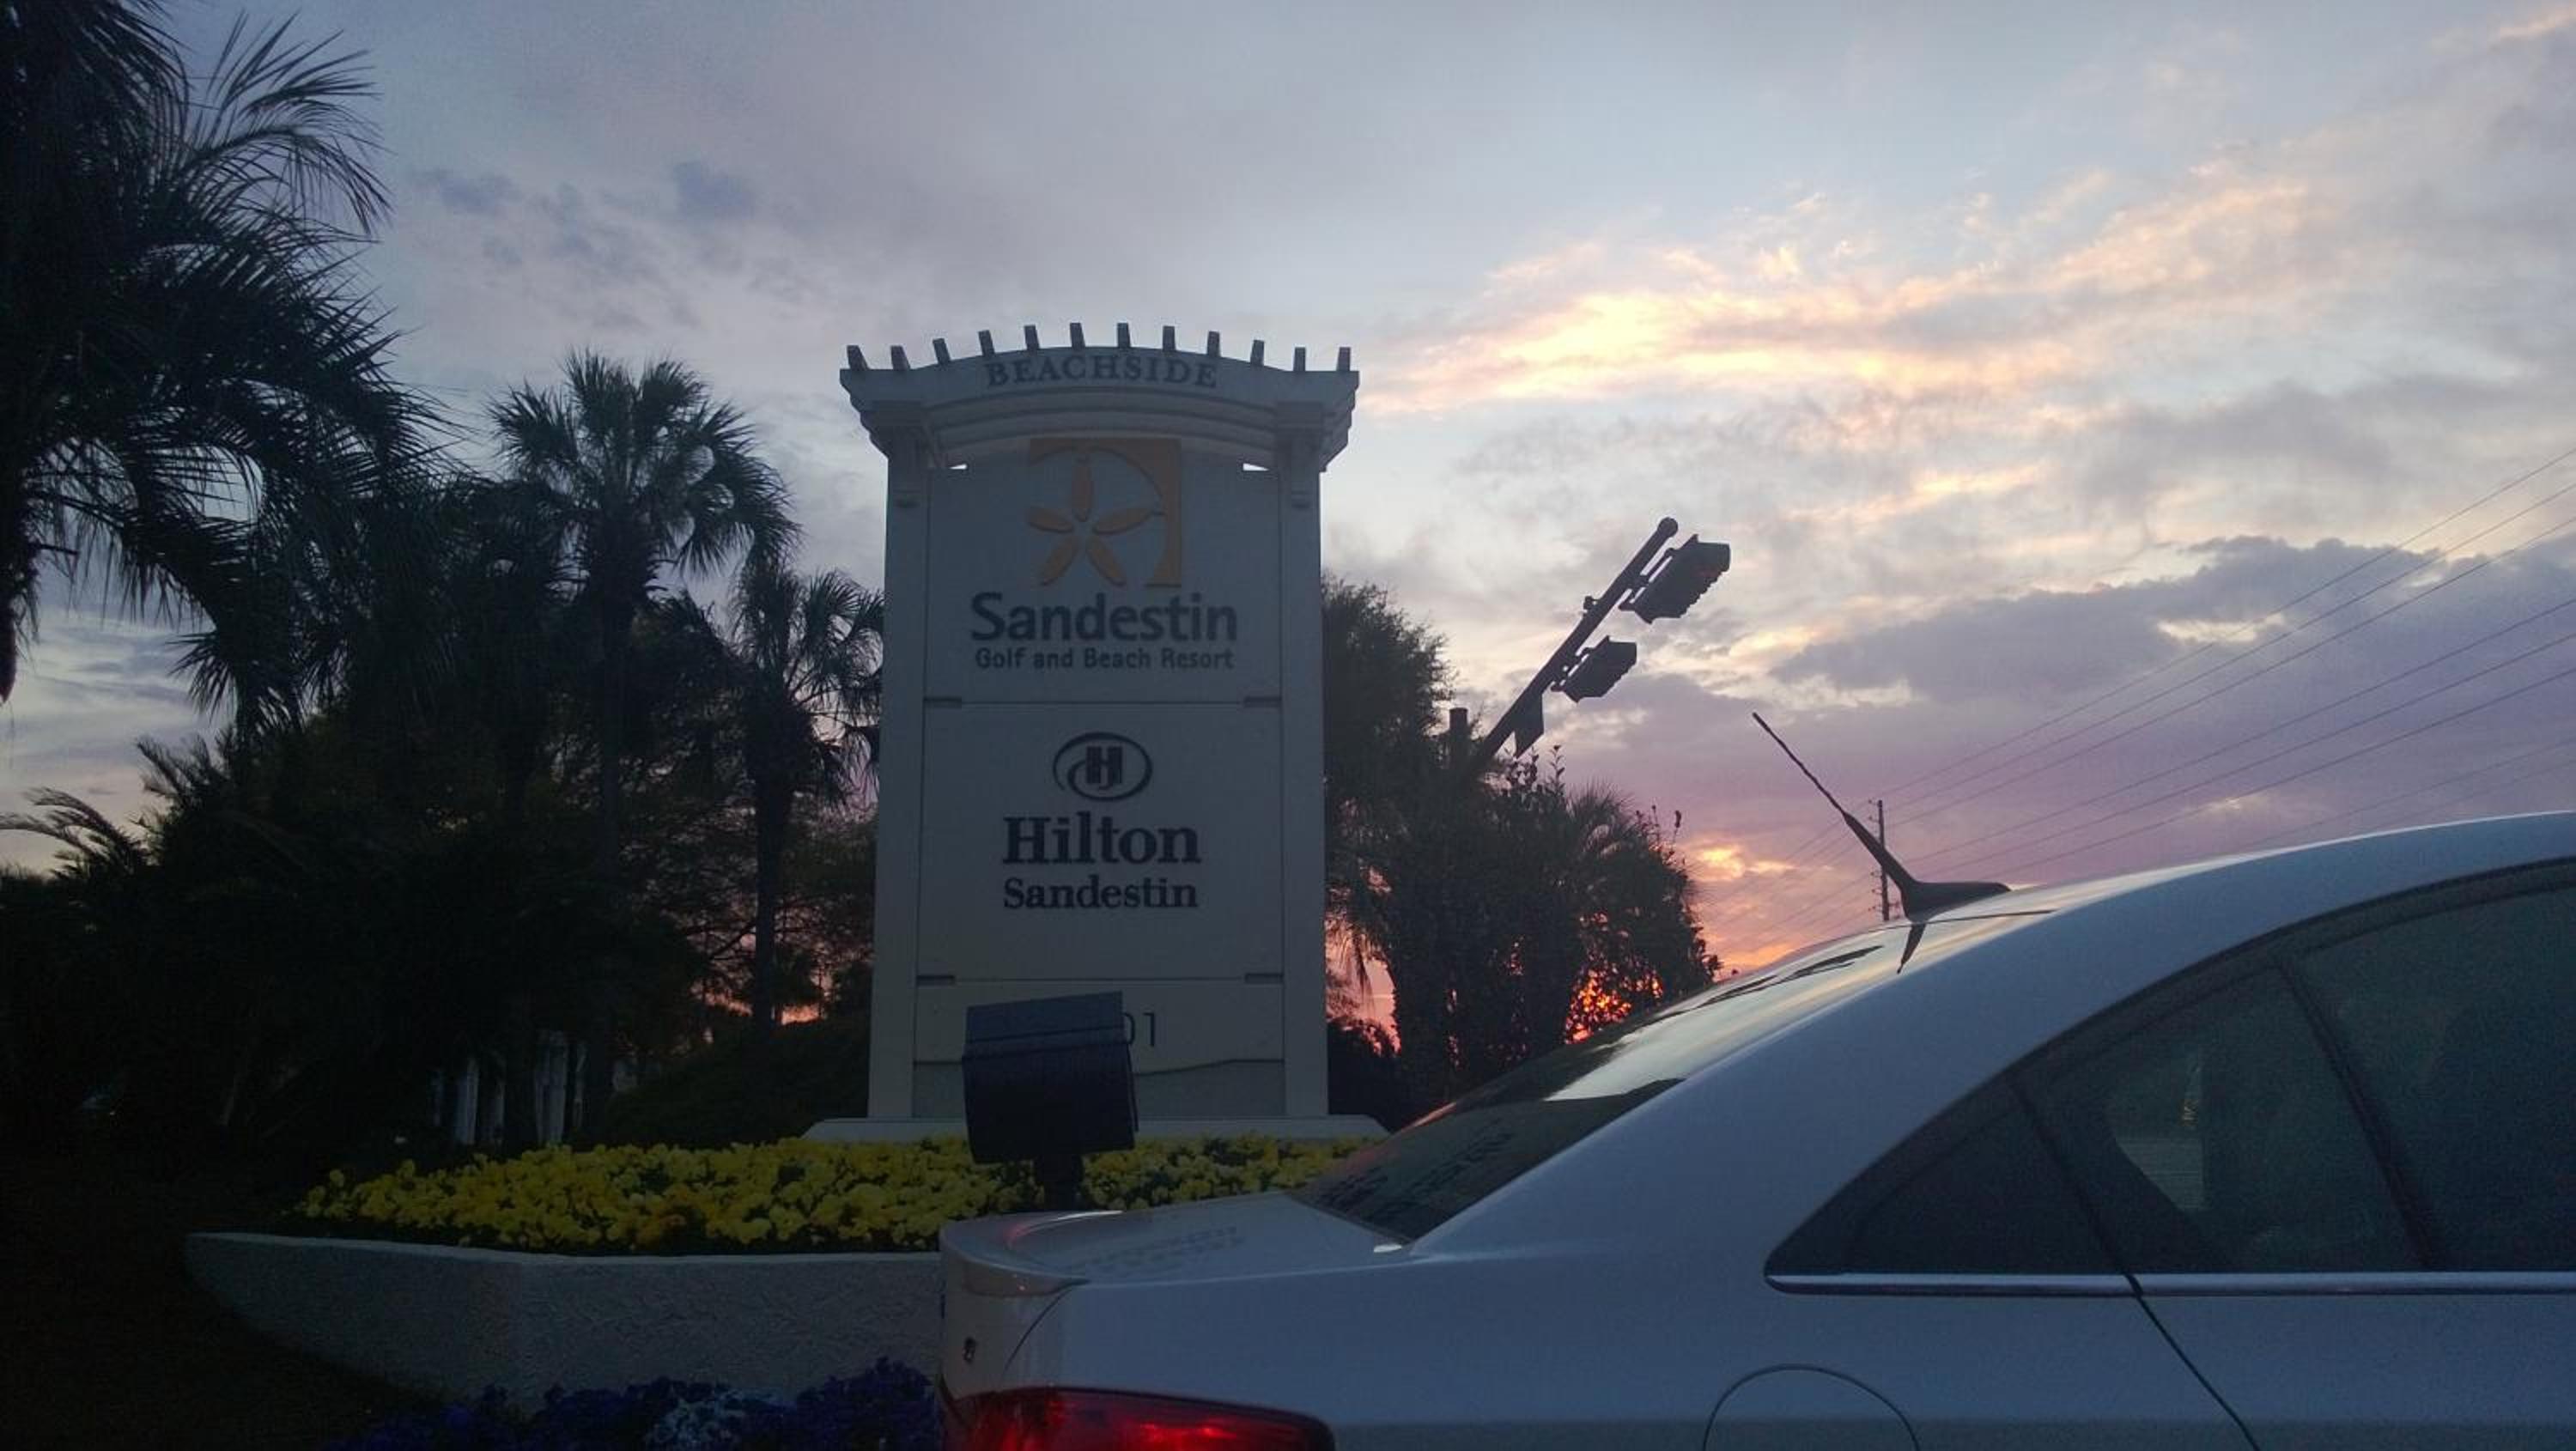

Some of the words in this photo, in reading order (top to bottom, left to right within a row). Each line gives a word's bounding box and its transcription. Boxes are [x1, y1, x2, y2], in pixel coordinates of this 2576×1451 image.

[985, 353, 1218, 389] BEACHSIDE
[969, 591, 1237, 642] Sandestin
[975, 647, 1027, 670] Golf
[1032, 647, 1074, 670] and
[1083, 647, 1151, 670] Beach
[1159, 647, 1236, 670] Resort
[1001, 810, 1203, 865] Hilton
[1002, 874, 1200, 910] Sandestin
